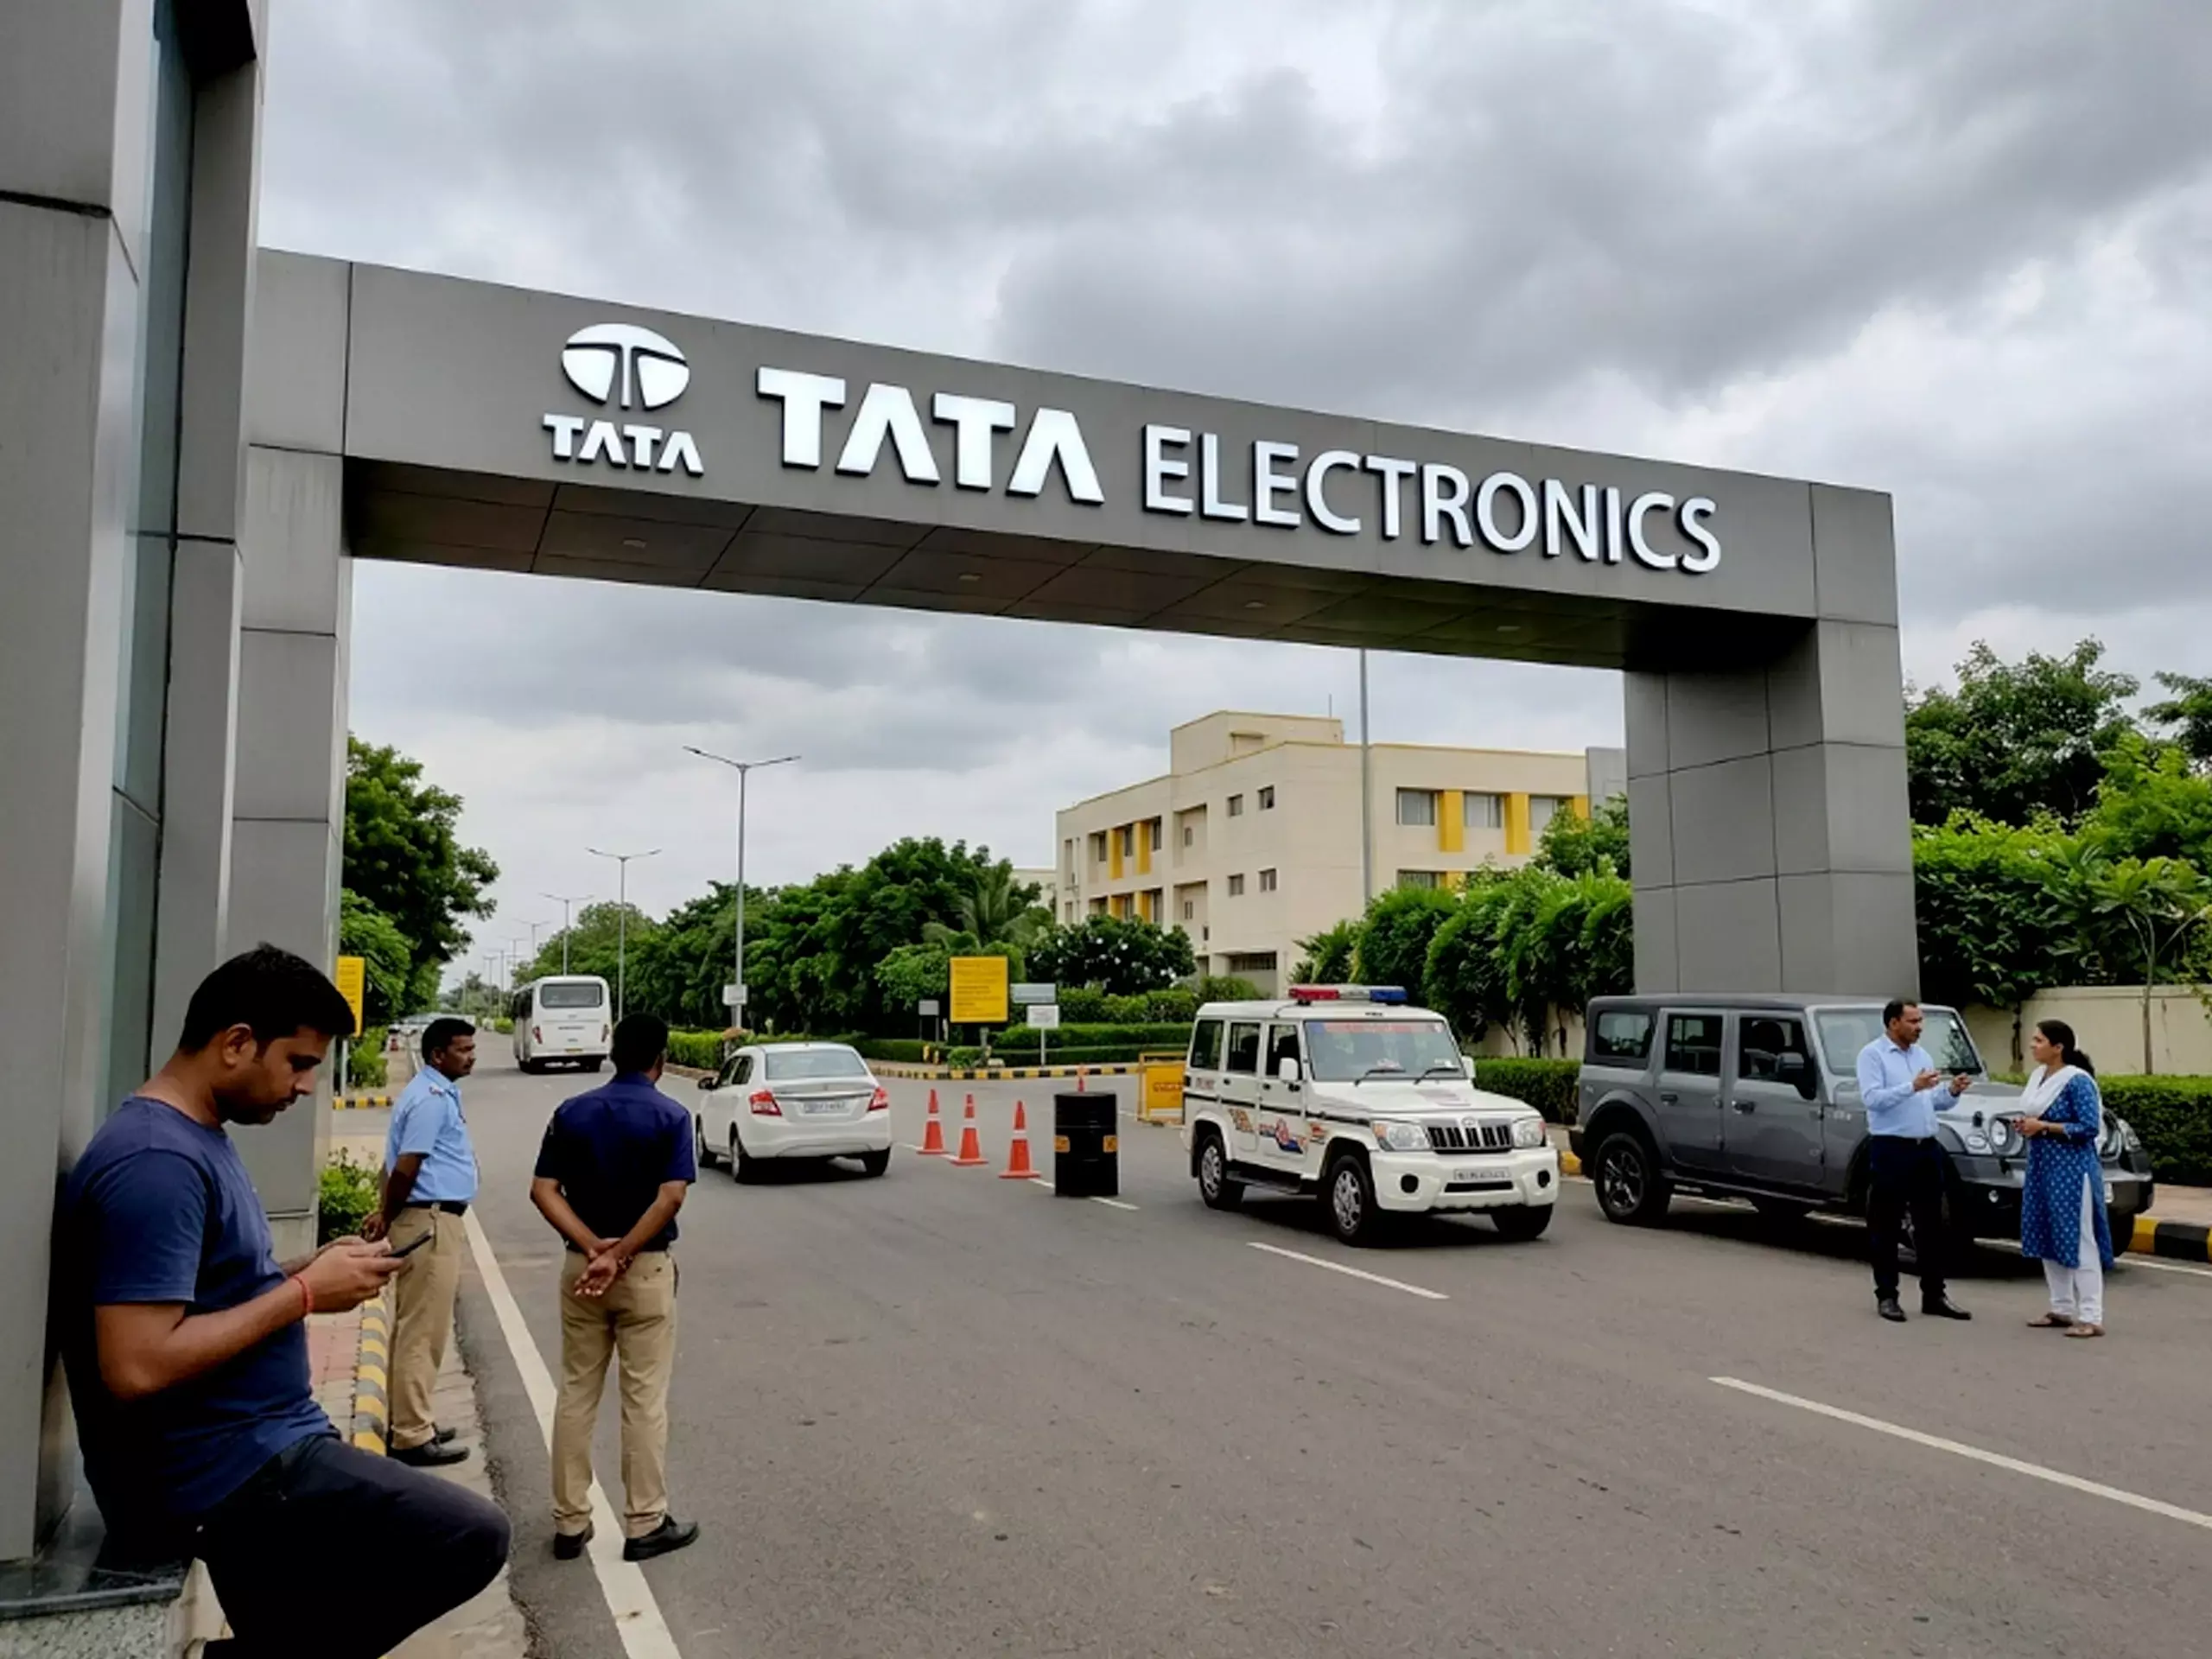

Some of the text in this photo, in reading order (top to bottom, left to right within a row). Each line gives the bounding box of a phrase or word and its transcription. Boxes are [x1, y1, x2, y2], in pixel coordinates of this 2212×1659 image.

[543, 413, 704, 476] TATA
[757, 366, 1722, 573] TATA ELECTRONICS
